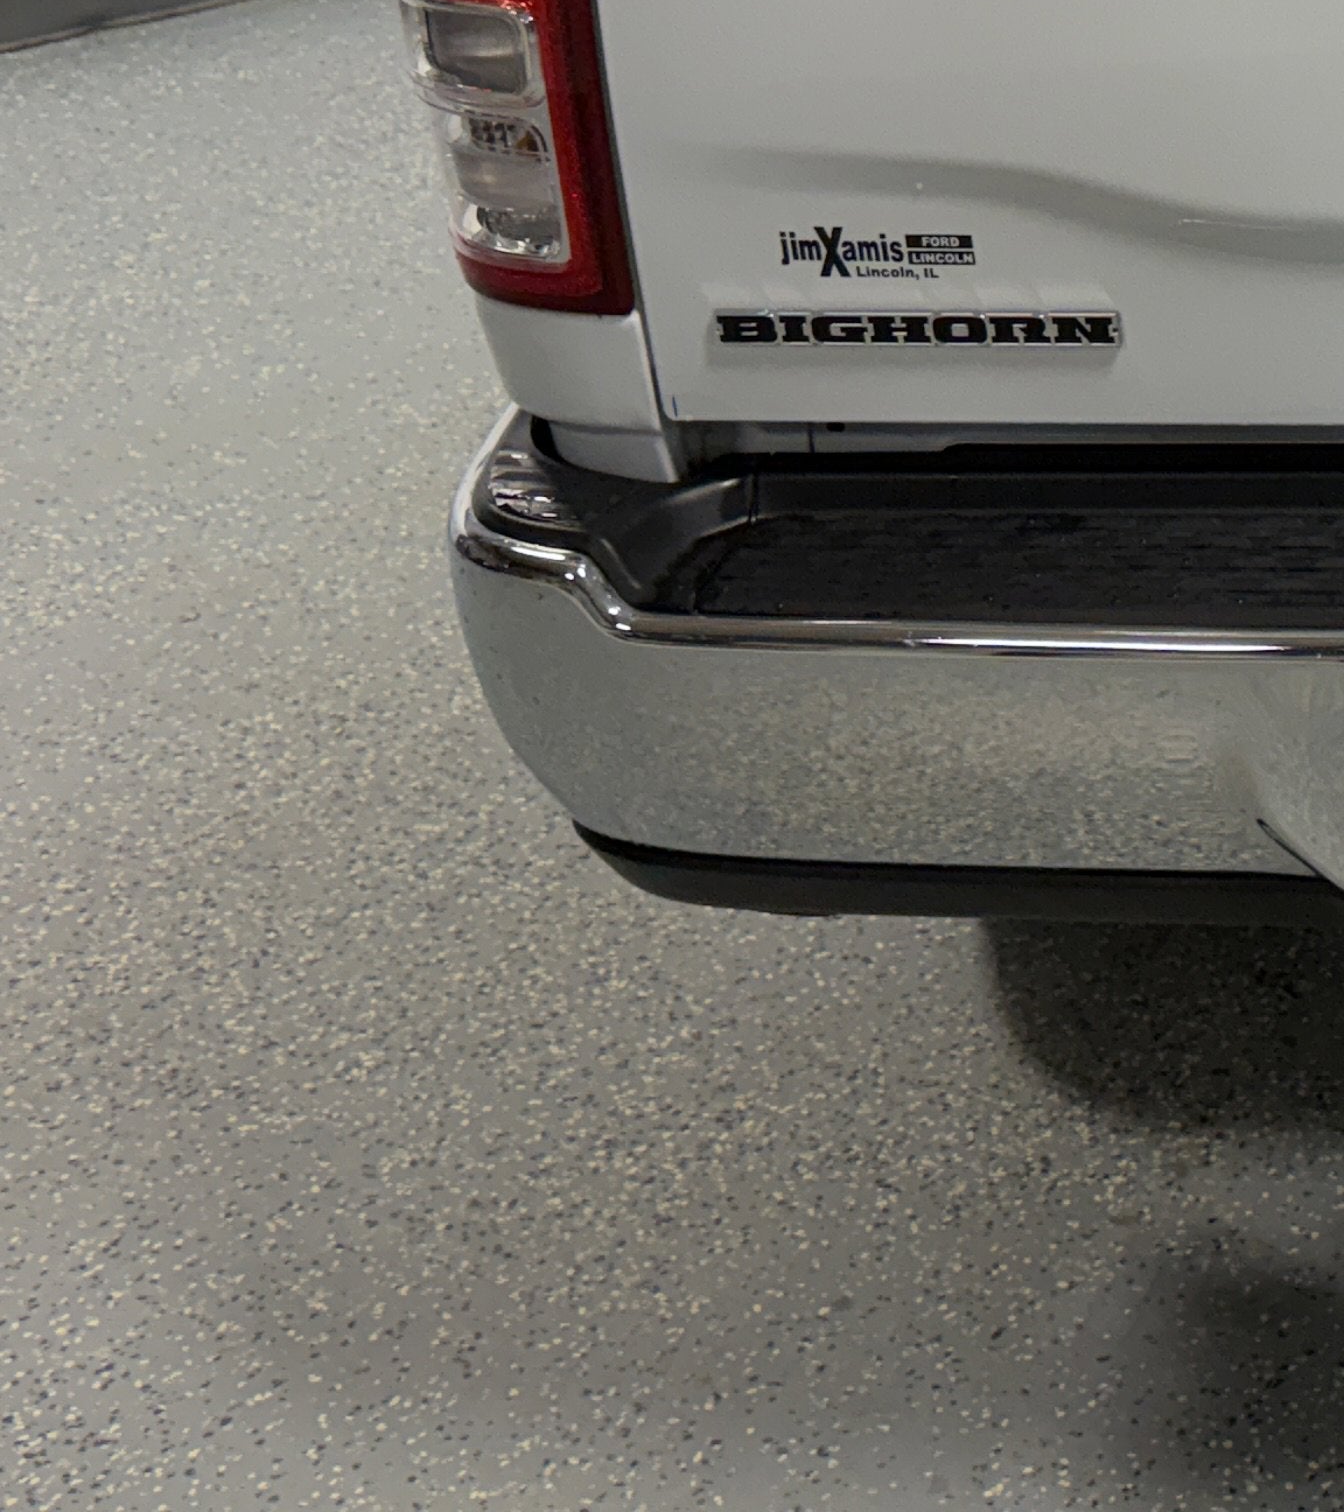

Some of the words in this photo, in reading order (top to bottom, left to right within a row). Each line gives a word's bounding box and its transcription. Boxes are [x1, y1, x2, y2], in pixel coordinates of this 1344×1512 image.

[921, 236, 961, 248] FORD
[911, 252, 974, 264] LINCOLN
[856, 266, 920, 281] Lincoln,
[924, 267, 940, 279] IL
[715, 314, 1119, 345] BIGHORN
